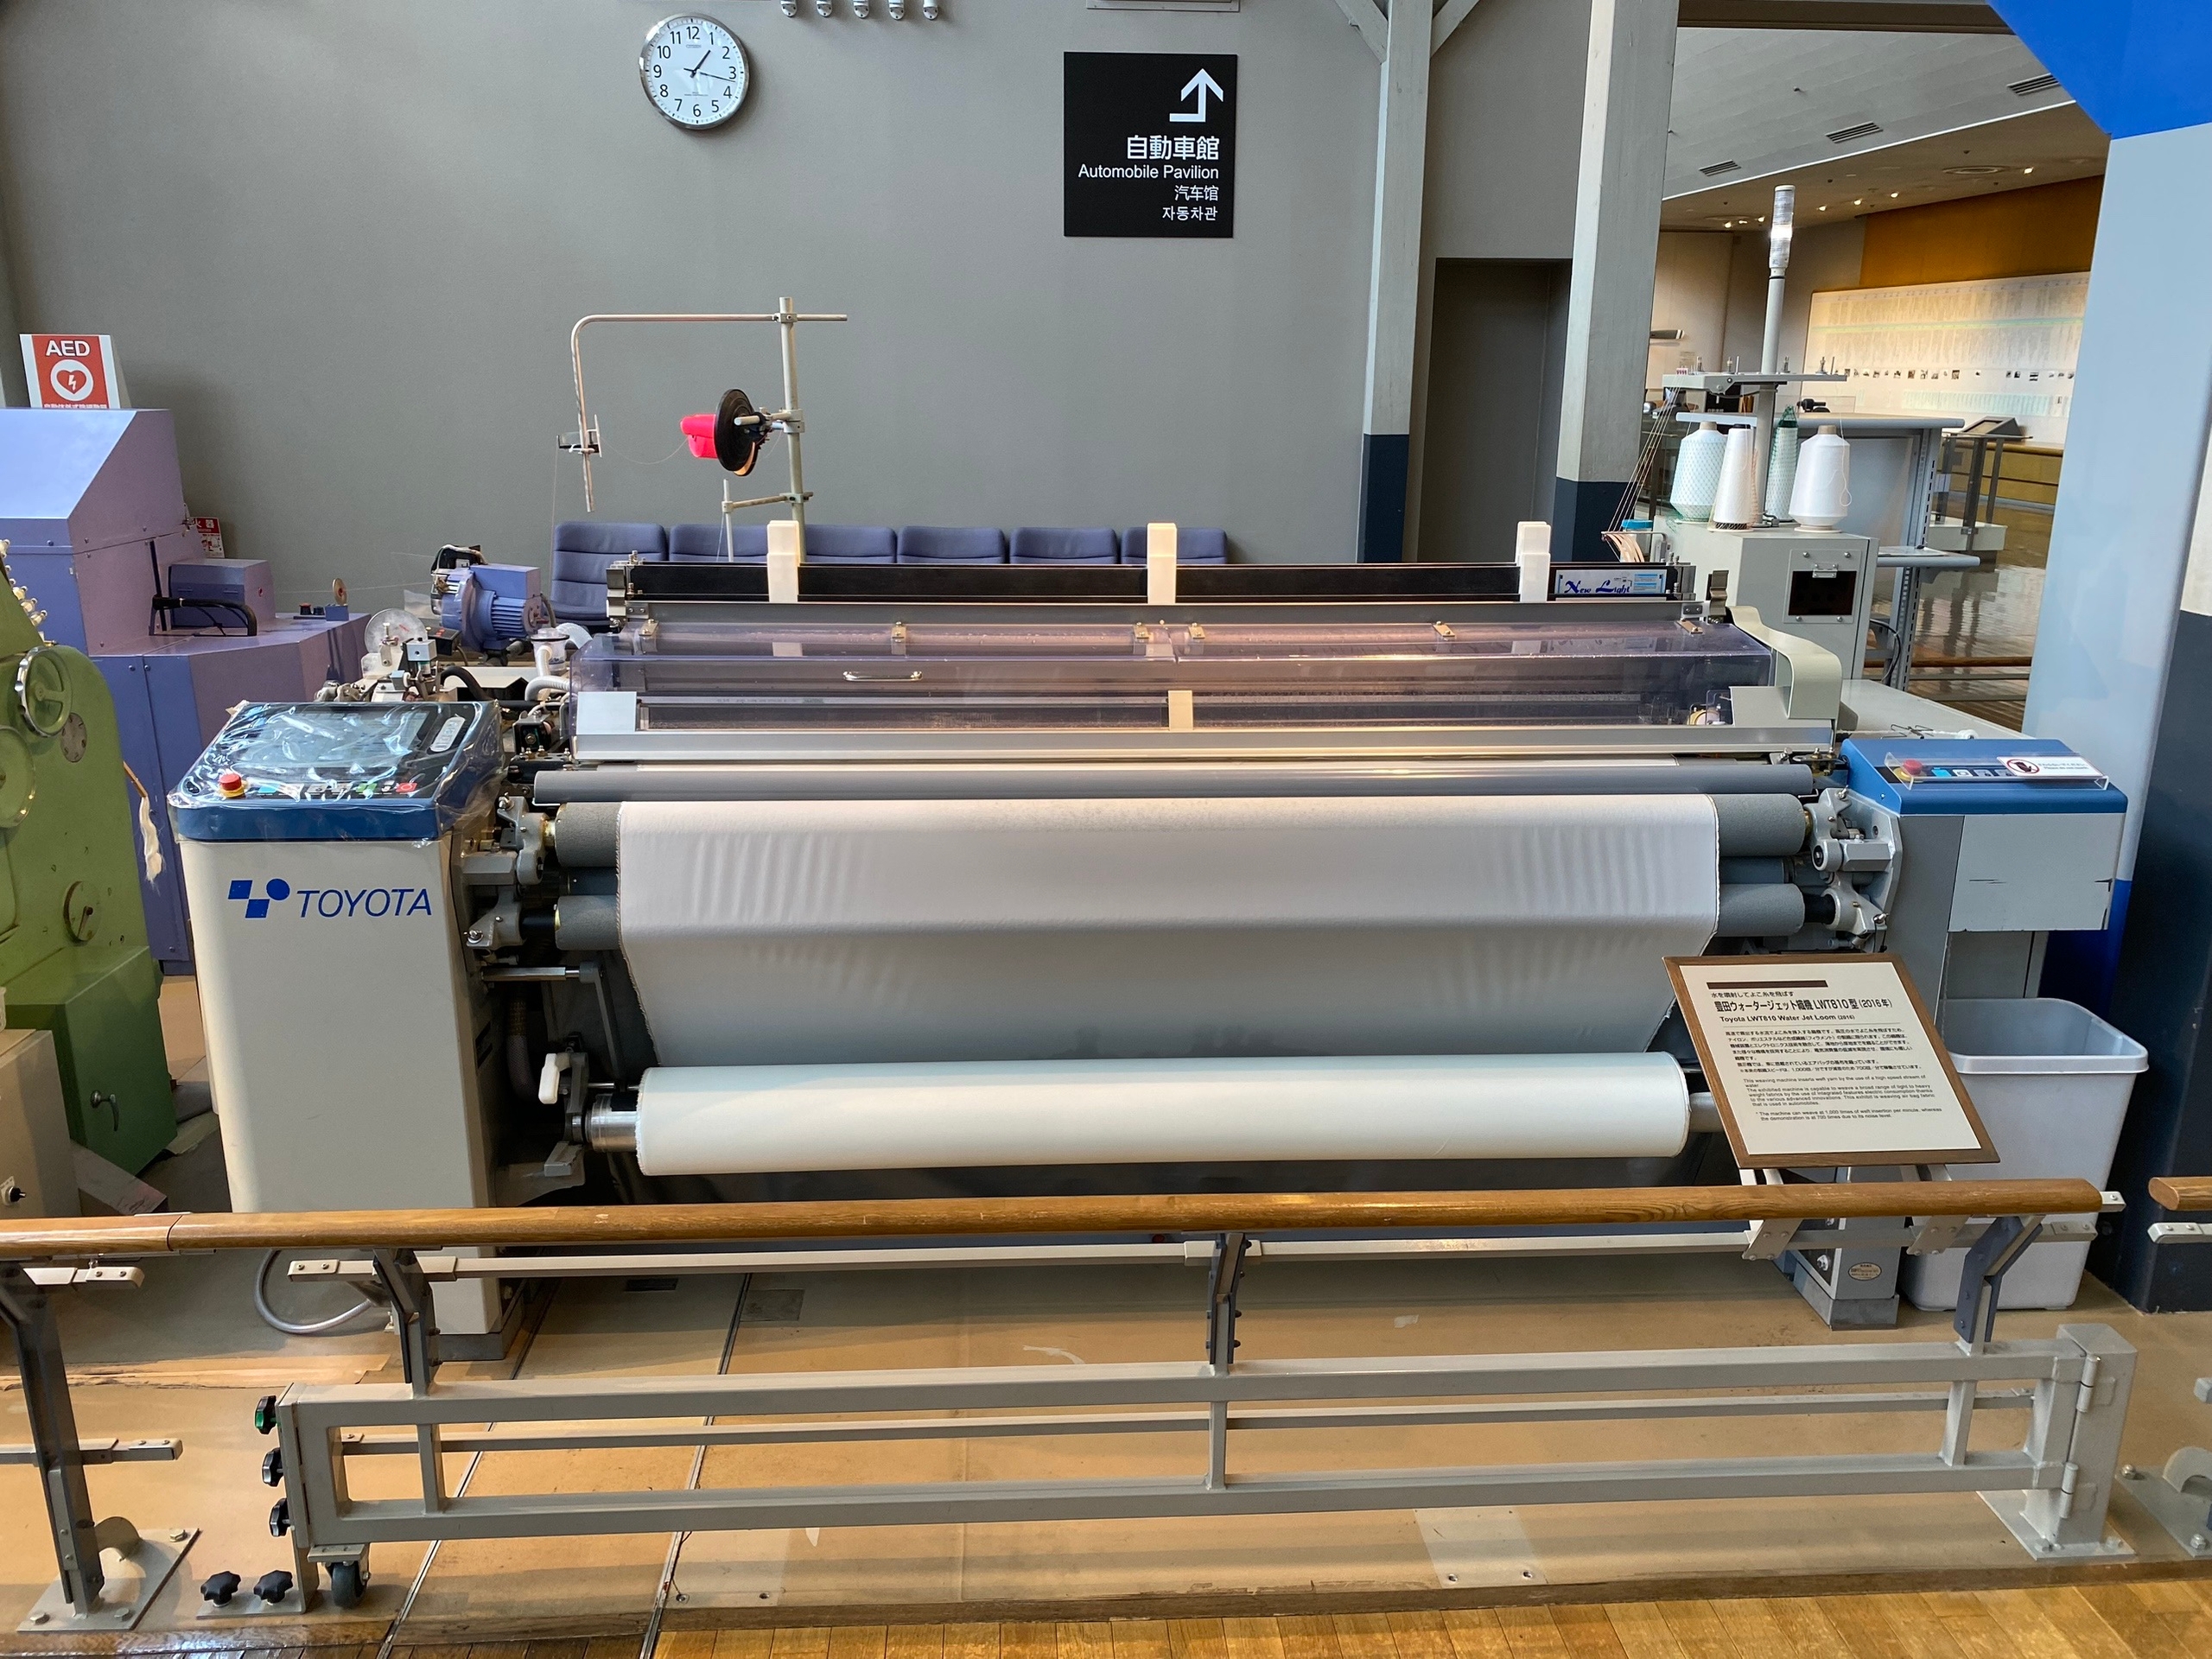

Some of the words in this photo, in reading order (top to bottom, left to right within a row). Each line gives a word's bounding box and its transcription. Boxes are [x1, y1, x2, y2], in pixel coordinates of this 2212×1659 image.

[670, 31, 681, 44] 11
[686, 26, 701, 40] 12
[709, 32, 714, 45] 1
[657, 45, 671, 59] 10
[722, 46, 730, 60] 2
[653, 64, 662, 78] 9
[728, 66, 737, 79] 3
[659, 84, 669, 98] 8
[723, 86, 732, 99] 4
[674, 99, 683, 111] 7
[693, 104, 701, 117] 6
[711, 99, 719, 113] 5
[1127, 135, 1220, 160] 自動車館
[1078, 164, 1159, 179] Automobile
[1163, 165, 1219, 179] Pavilion
[1174, 184, 1218, 201] 汽车馆
[1162, 206, 1218, 220] 자동차관
[46, 340, 90, 356] AED
[1564, 580, 1592, 594] New
[1595, 579, 1630, 594] Light
[296, 888, 432, 918] TOYOTA
[1812, 998, 1849, 1010] LWT810
